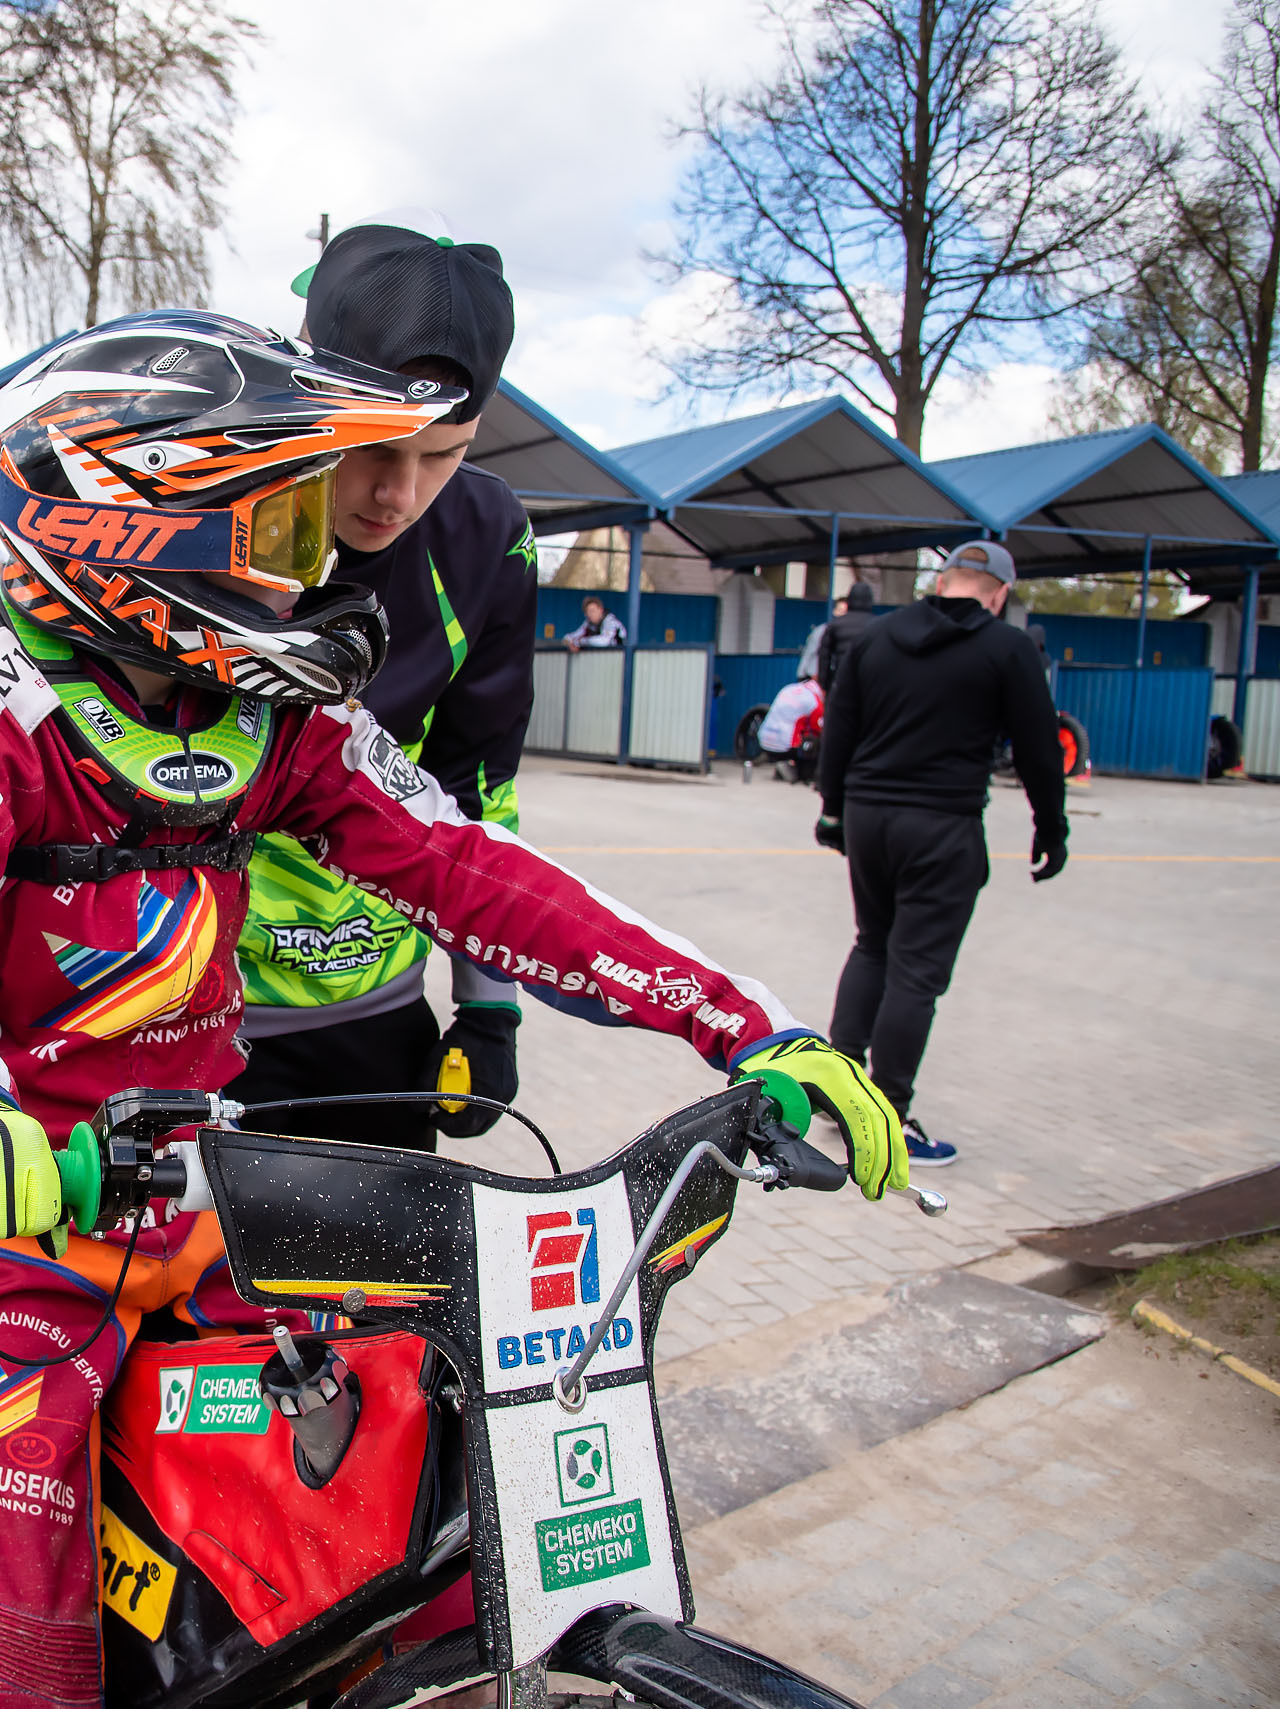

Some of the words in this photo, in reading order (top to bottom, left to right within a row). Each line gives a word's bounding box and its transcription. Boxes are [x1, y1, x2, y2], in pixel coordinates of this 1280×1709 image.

[17, 498, 203, 562] LEATT
[234, 516, 249, 568] LEATT
[155, 764, 228, 781] ORTEMA
[307, 951, 381, 973] RACING
[589, 950, 652, 993] RACE
[193, 1014, 226, 1033] 1989
[200, 1377, 261, 1400] CHEMEK
[200, 1403, 261, 1425] SYSTEM
[48, 1508, 75, 1527] 1989
[544, 1512, 637, 1553] CHEMEKO
[556, 1537, 634, 1576] SYSTEM
